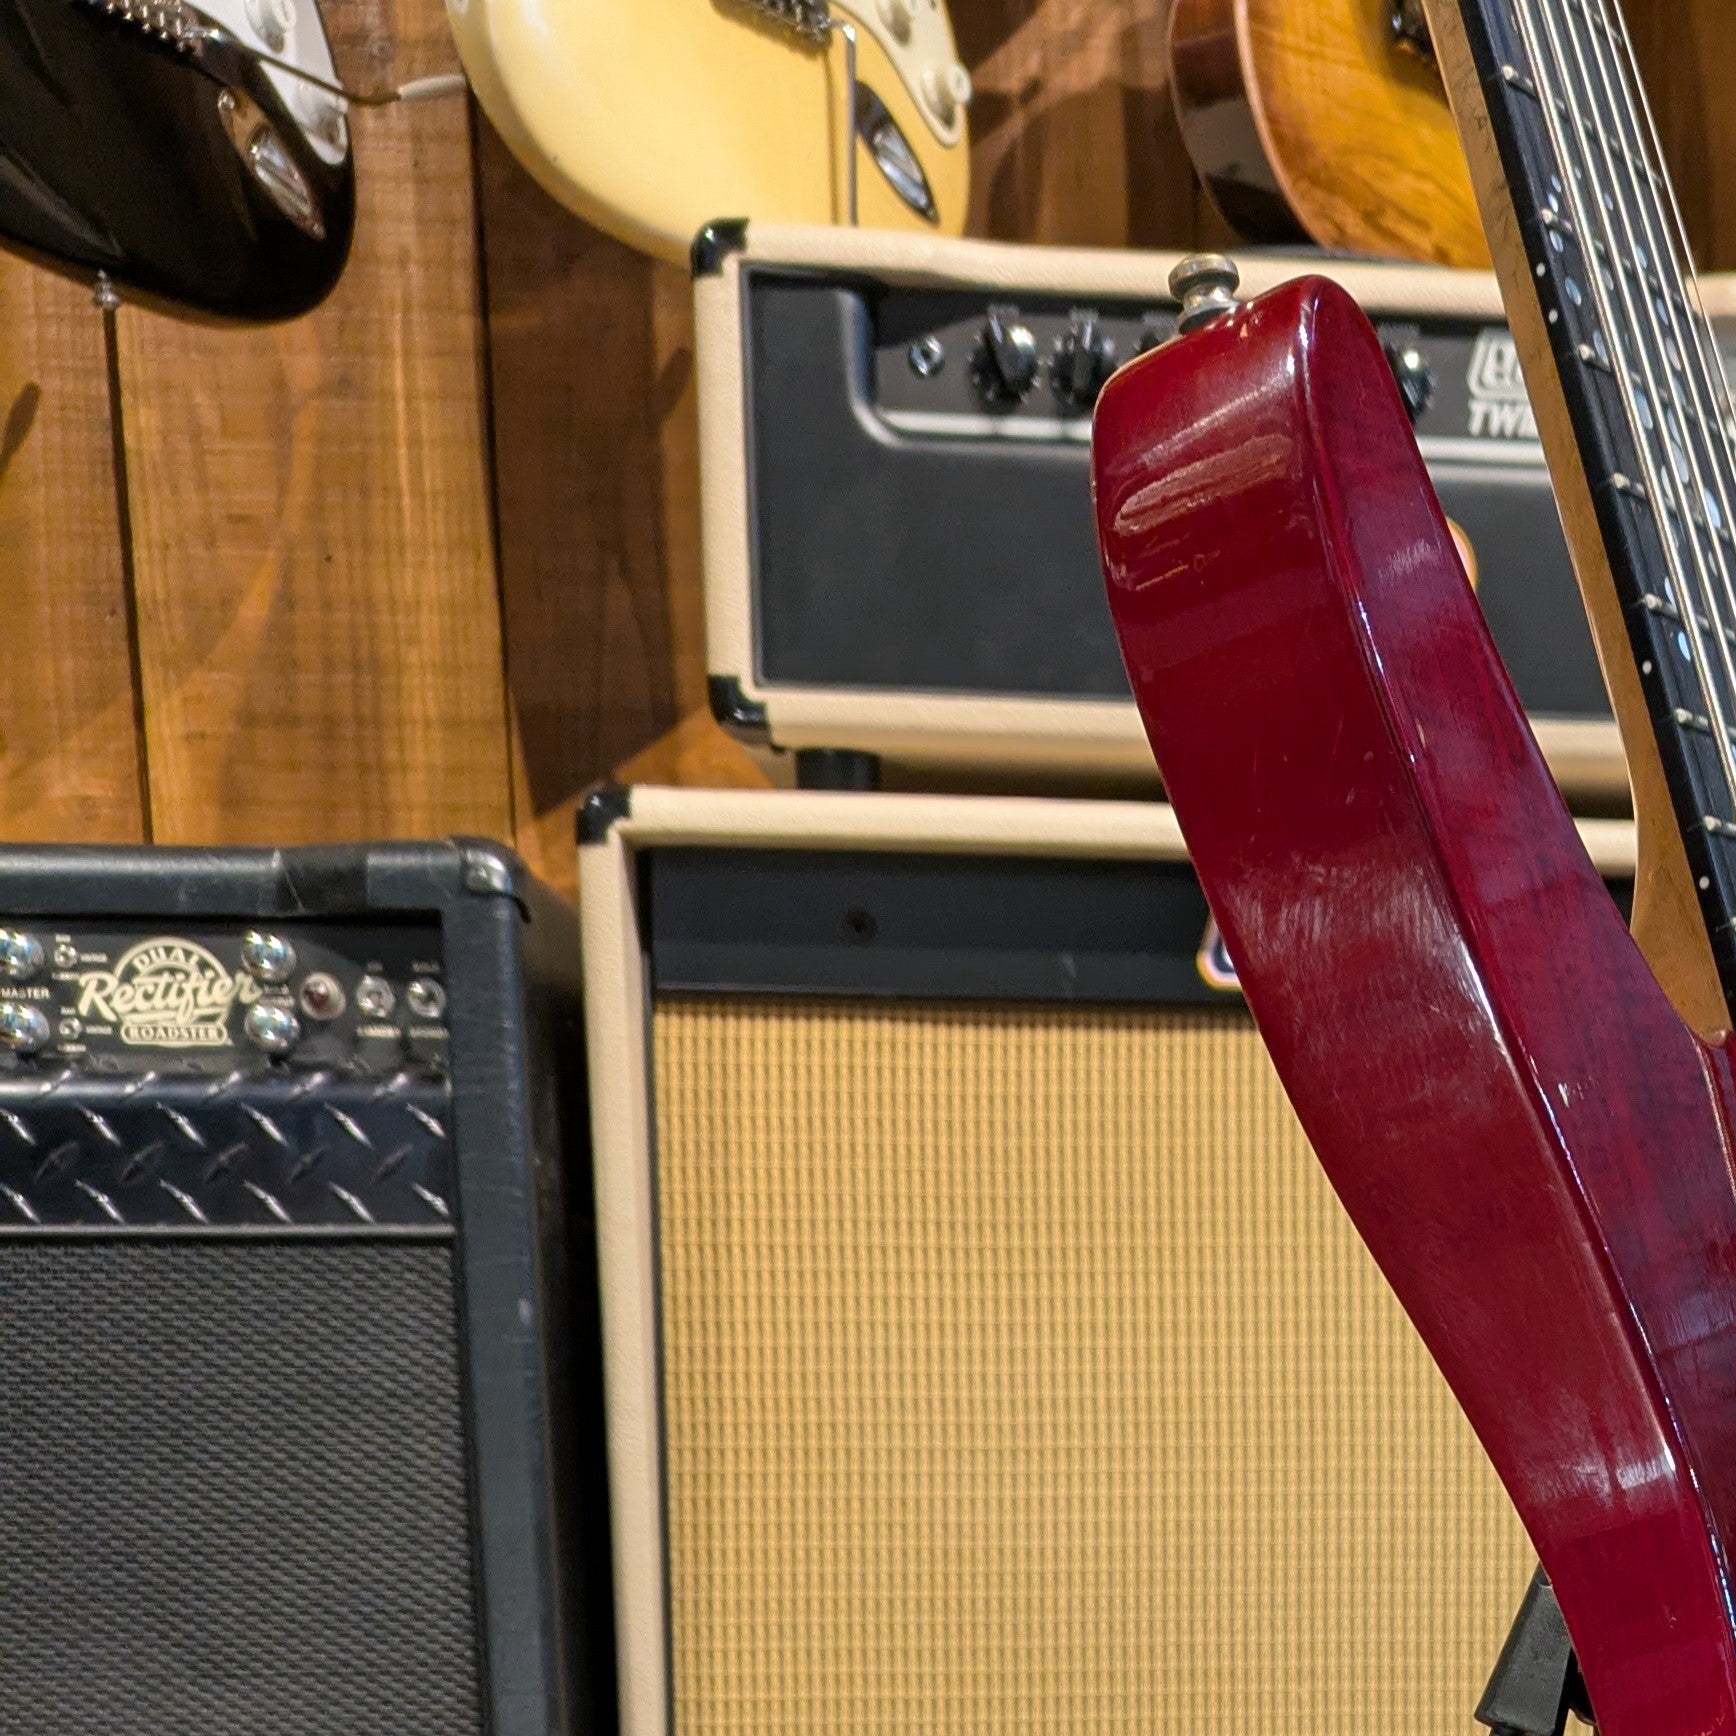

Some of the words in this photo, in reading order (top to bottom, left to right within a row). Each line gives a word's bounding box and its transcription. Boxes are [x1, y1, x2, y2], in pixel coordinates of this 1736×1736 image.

[131, 945, 200, 974] DUAL
[1, 985, 50, 1000] MASTER
[78, 970, 263, 1026] Rectifier
[127, 1025, 220, 1040] ROADSTER
